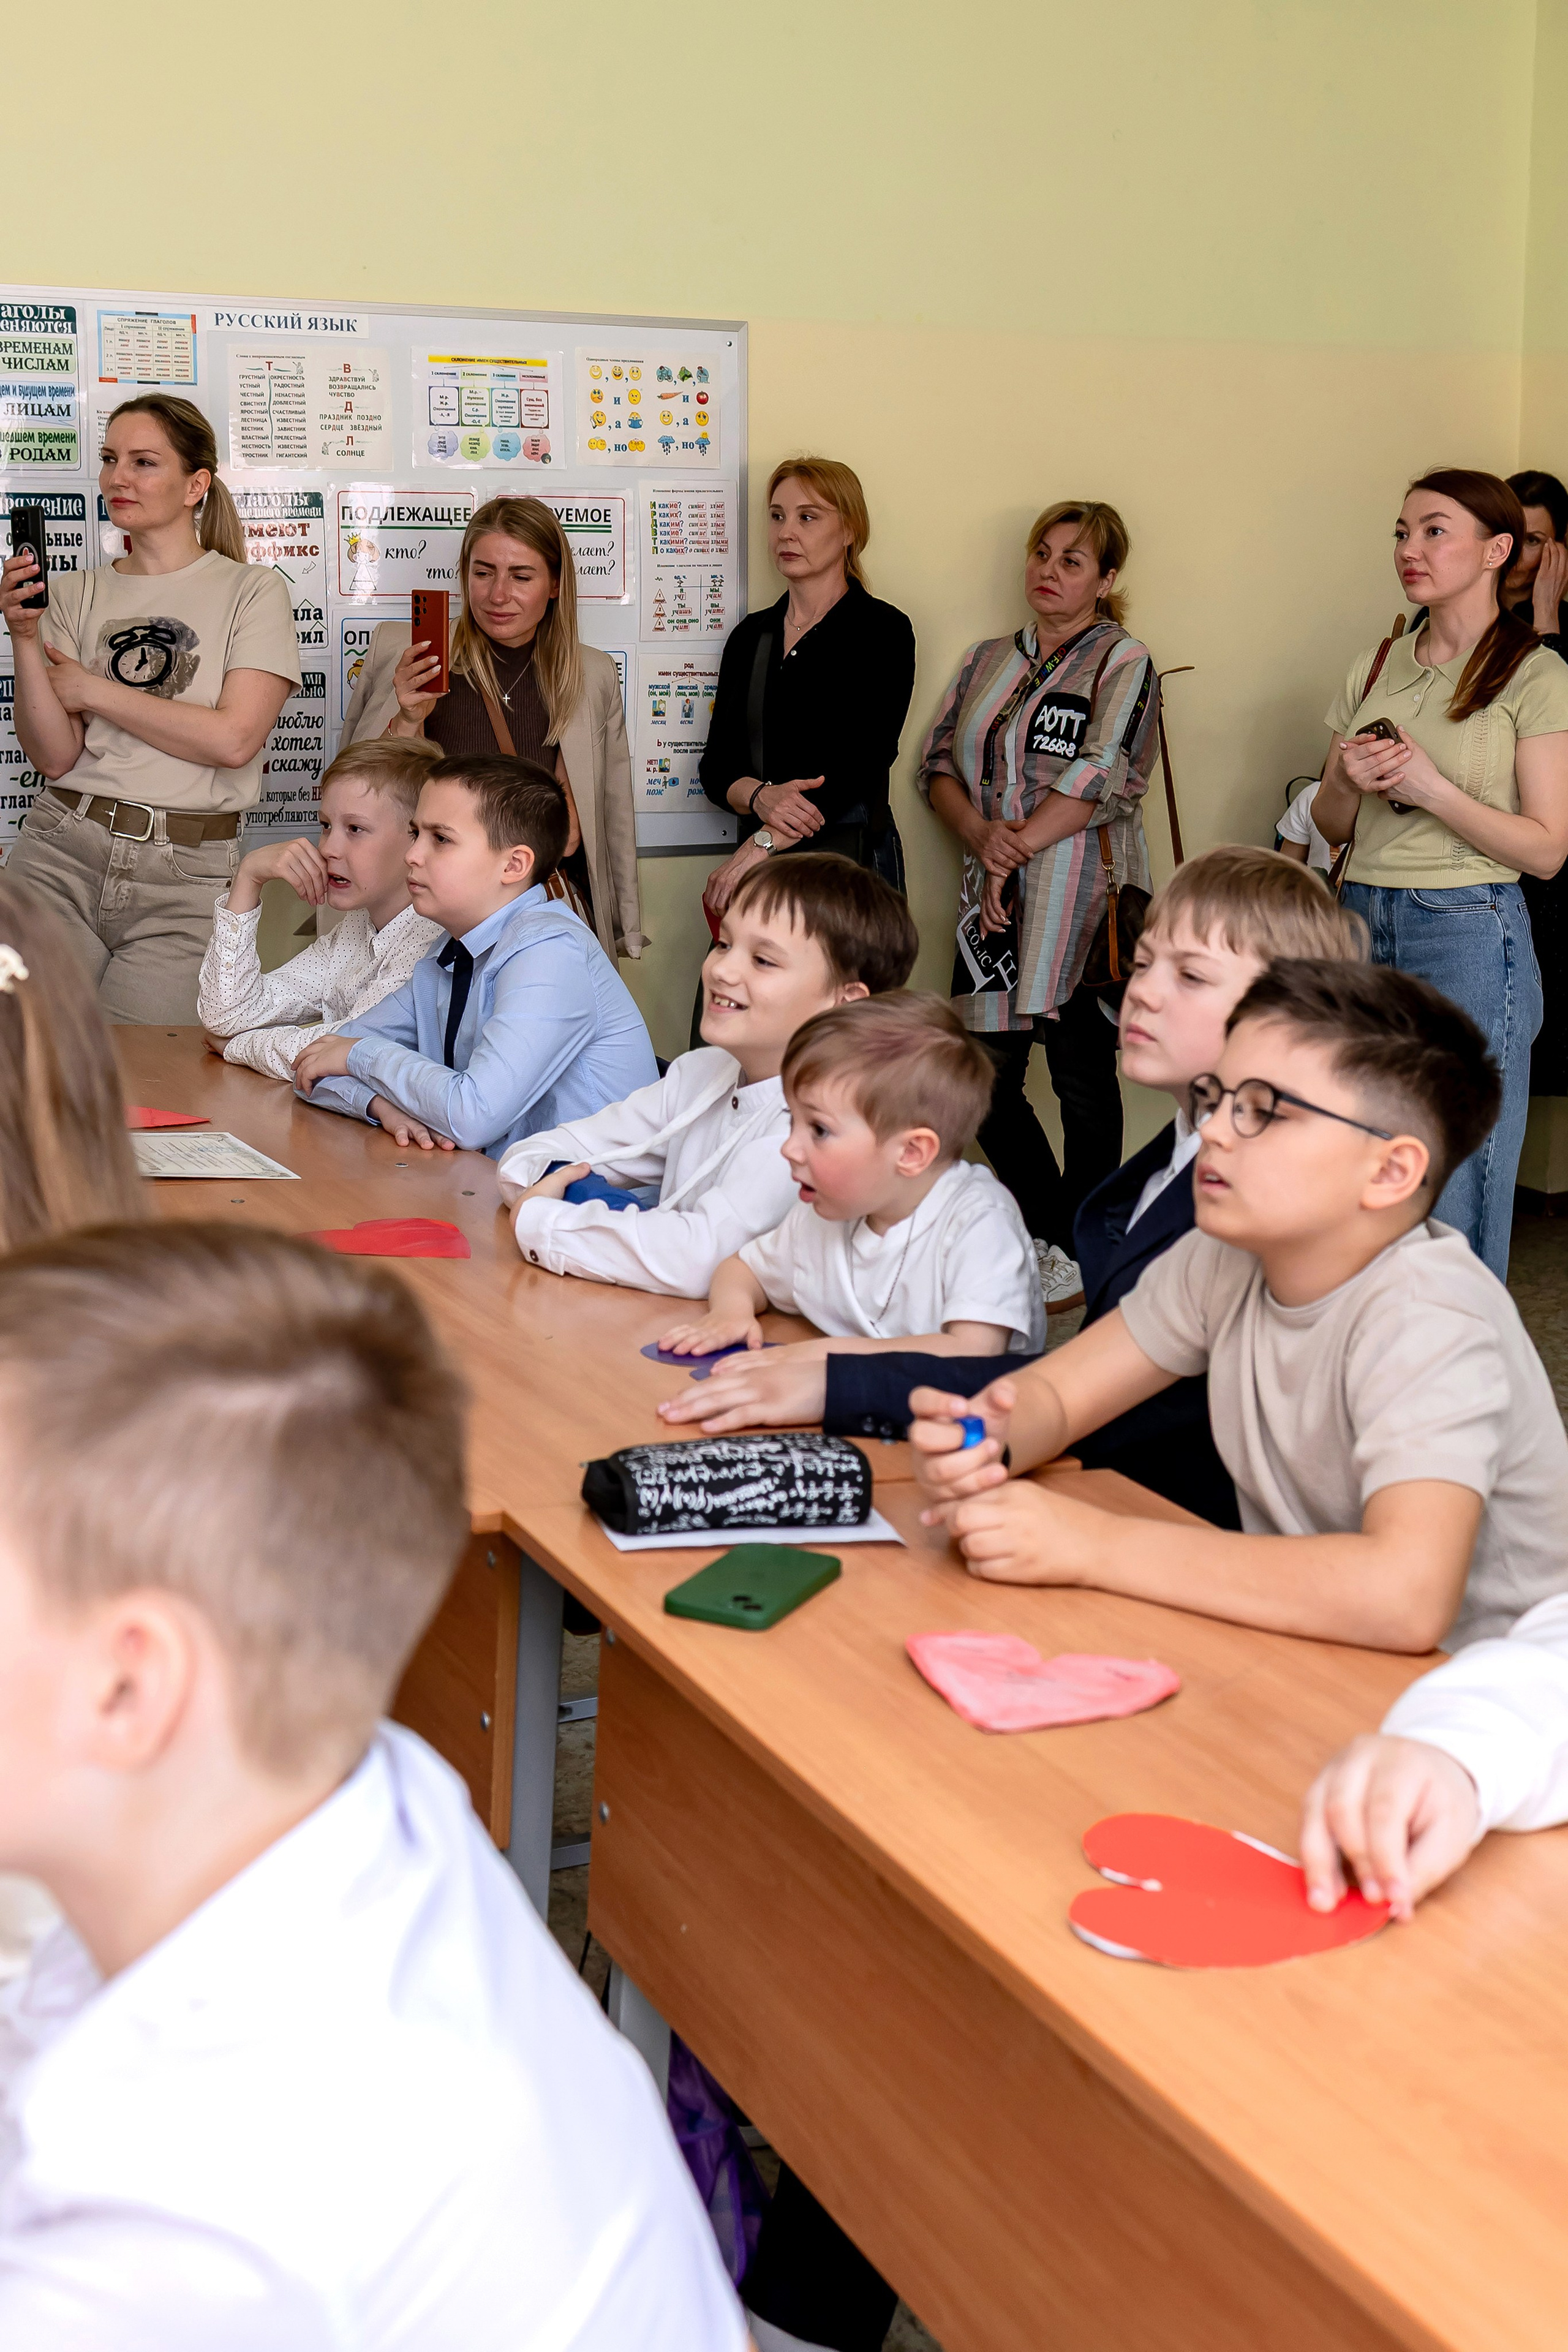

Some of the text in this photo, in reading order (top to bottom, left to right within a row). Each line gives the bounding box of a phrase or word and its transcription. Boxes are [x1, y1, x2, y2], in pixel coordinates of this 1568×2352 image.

[214, 312, 357, 331] РУССКИЙ ЯЗЫК
[2, 357, 70, 371] ЧИСЛАМ
[344, 364, 351, 373] В
[12, 385, 75, 401] и будущем времени
[4, 403, 71, 417] ЛИЦАМ
[344, 401, 353, 413] Д
[37, 432, 76, 447] времени
[346, 436, 353, 445] Л
[9, 448, 71, 462] РОДАМ
[342, 506, 471, 525] ПОДЛЕЖАЩЕЕ
[548, 508, 611, 522] УЕМОЕ
[385, 540, 427, 559] кто?
[271, 736, 323, 751] хотел
[271, 758, 323, 780] скажу
[266, 791, 296, 804] которые
[298, 786, 310, 801] без
